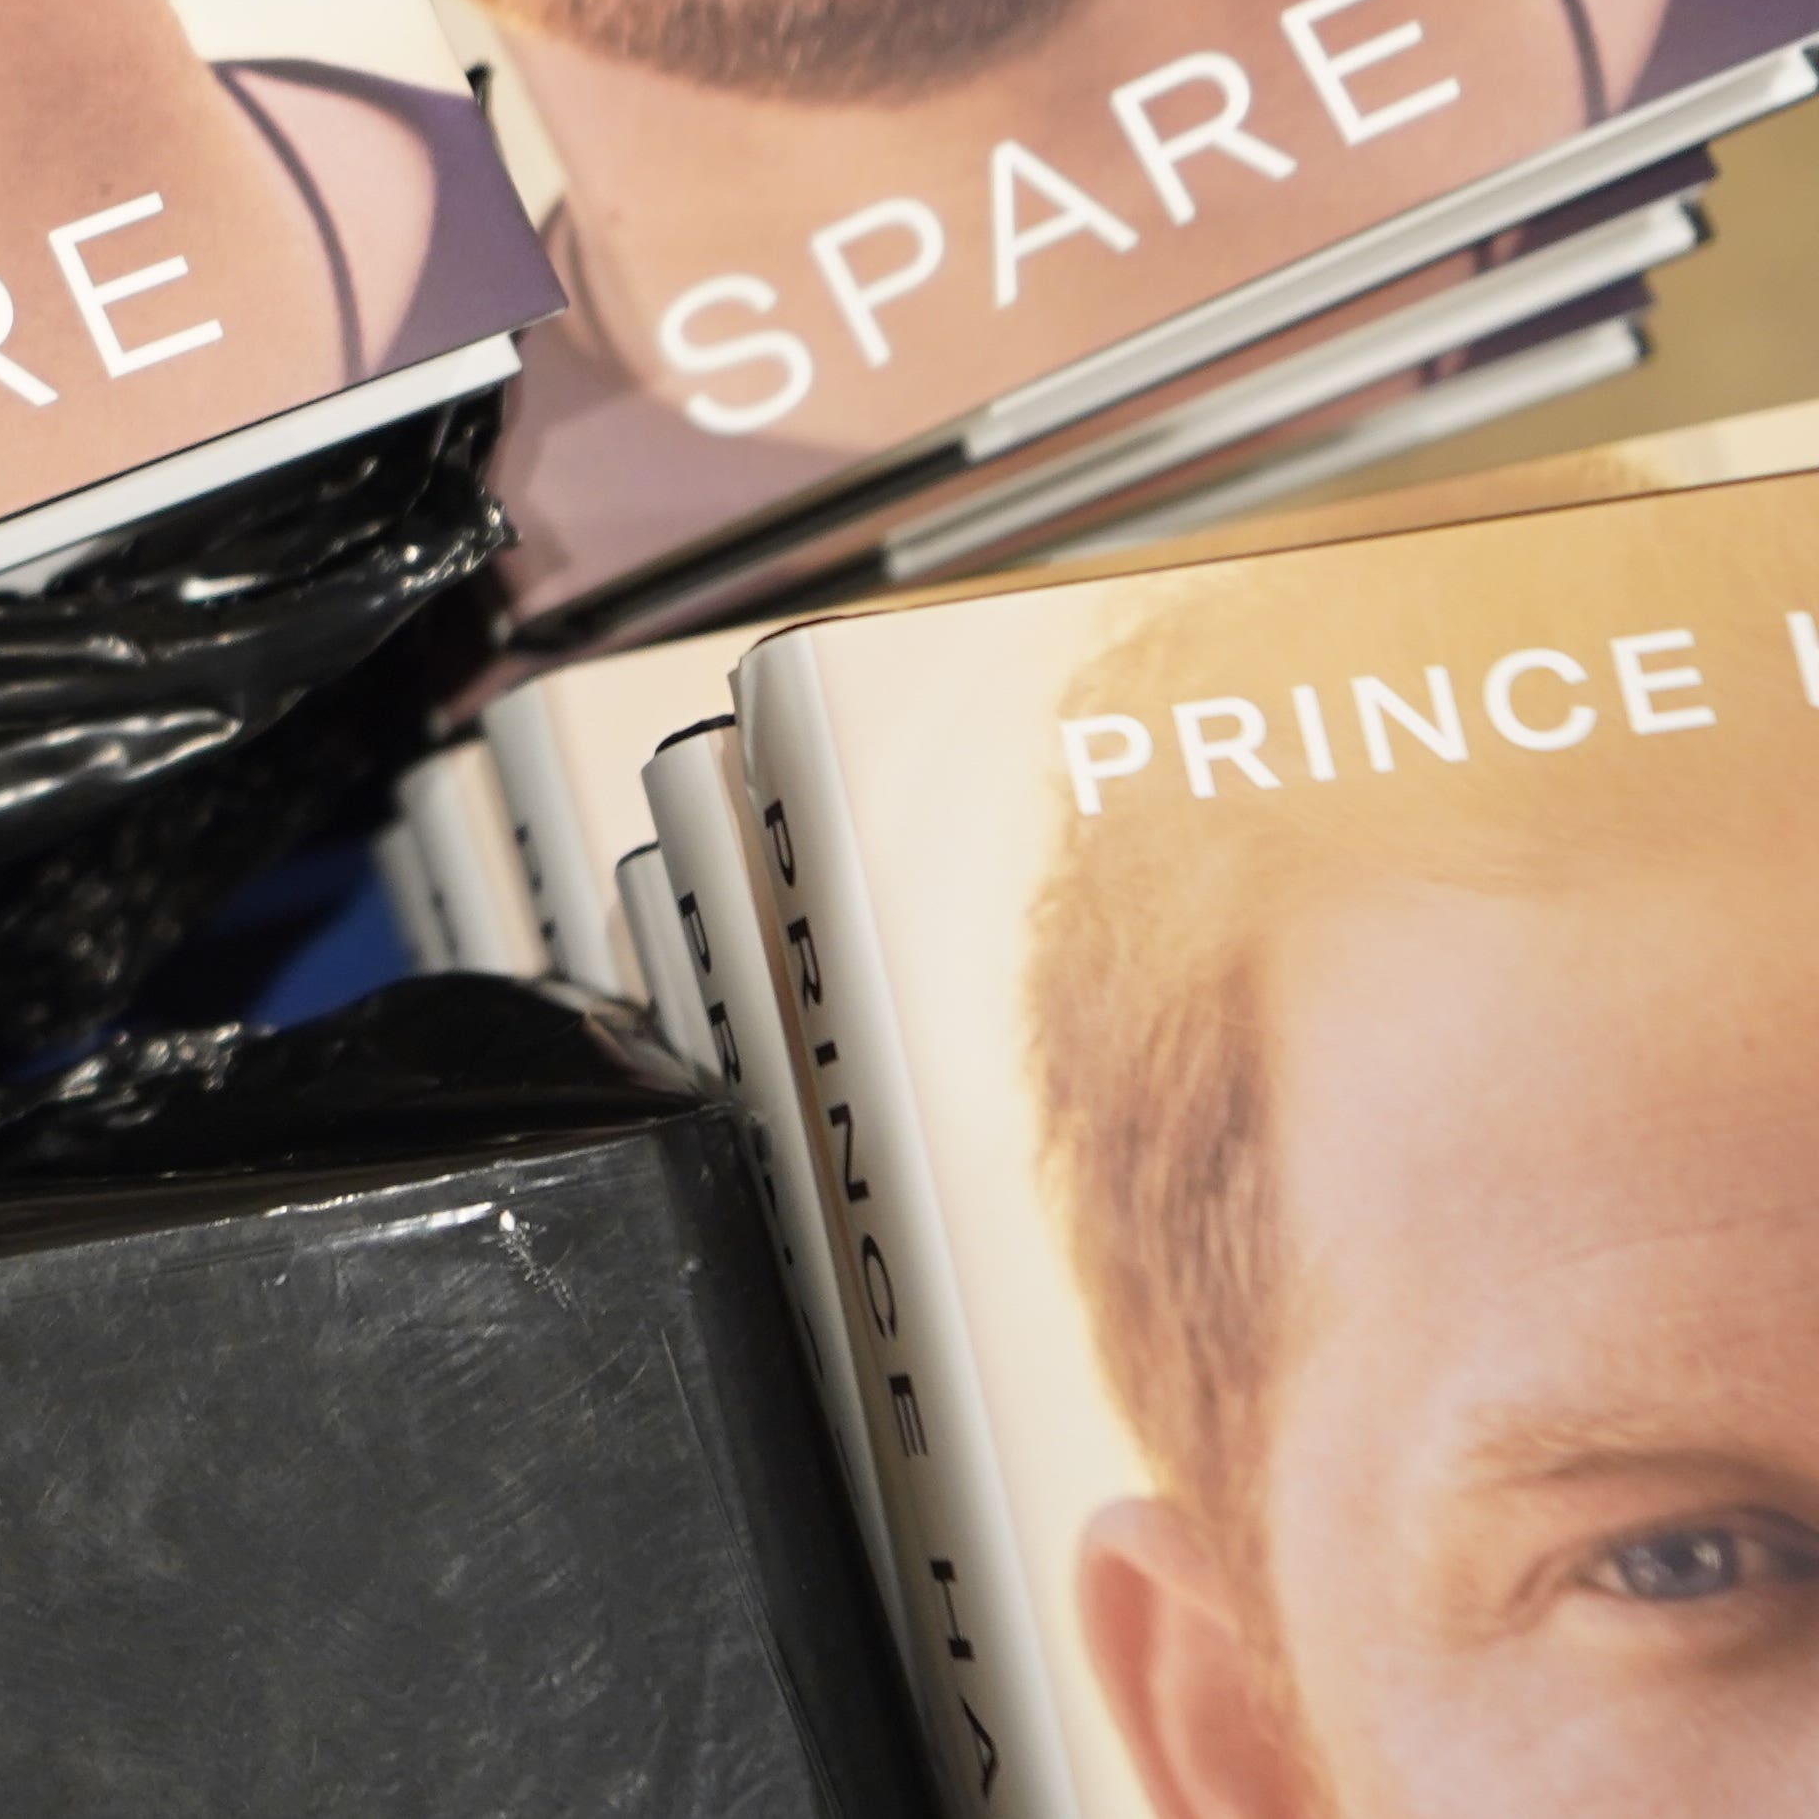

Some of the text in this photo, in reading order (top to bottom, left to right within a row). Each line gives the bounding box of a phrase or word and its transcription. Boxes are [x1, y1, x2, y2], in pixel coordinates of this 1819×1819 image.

[1059, 627, 1717, 817] PRINCE
[764, 799, 1000, 1800] PRINCE HA
